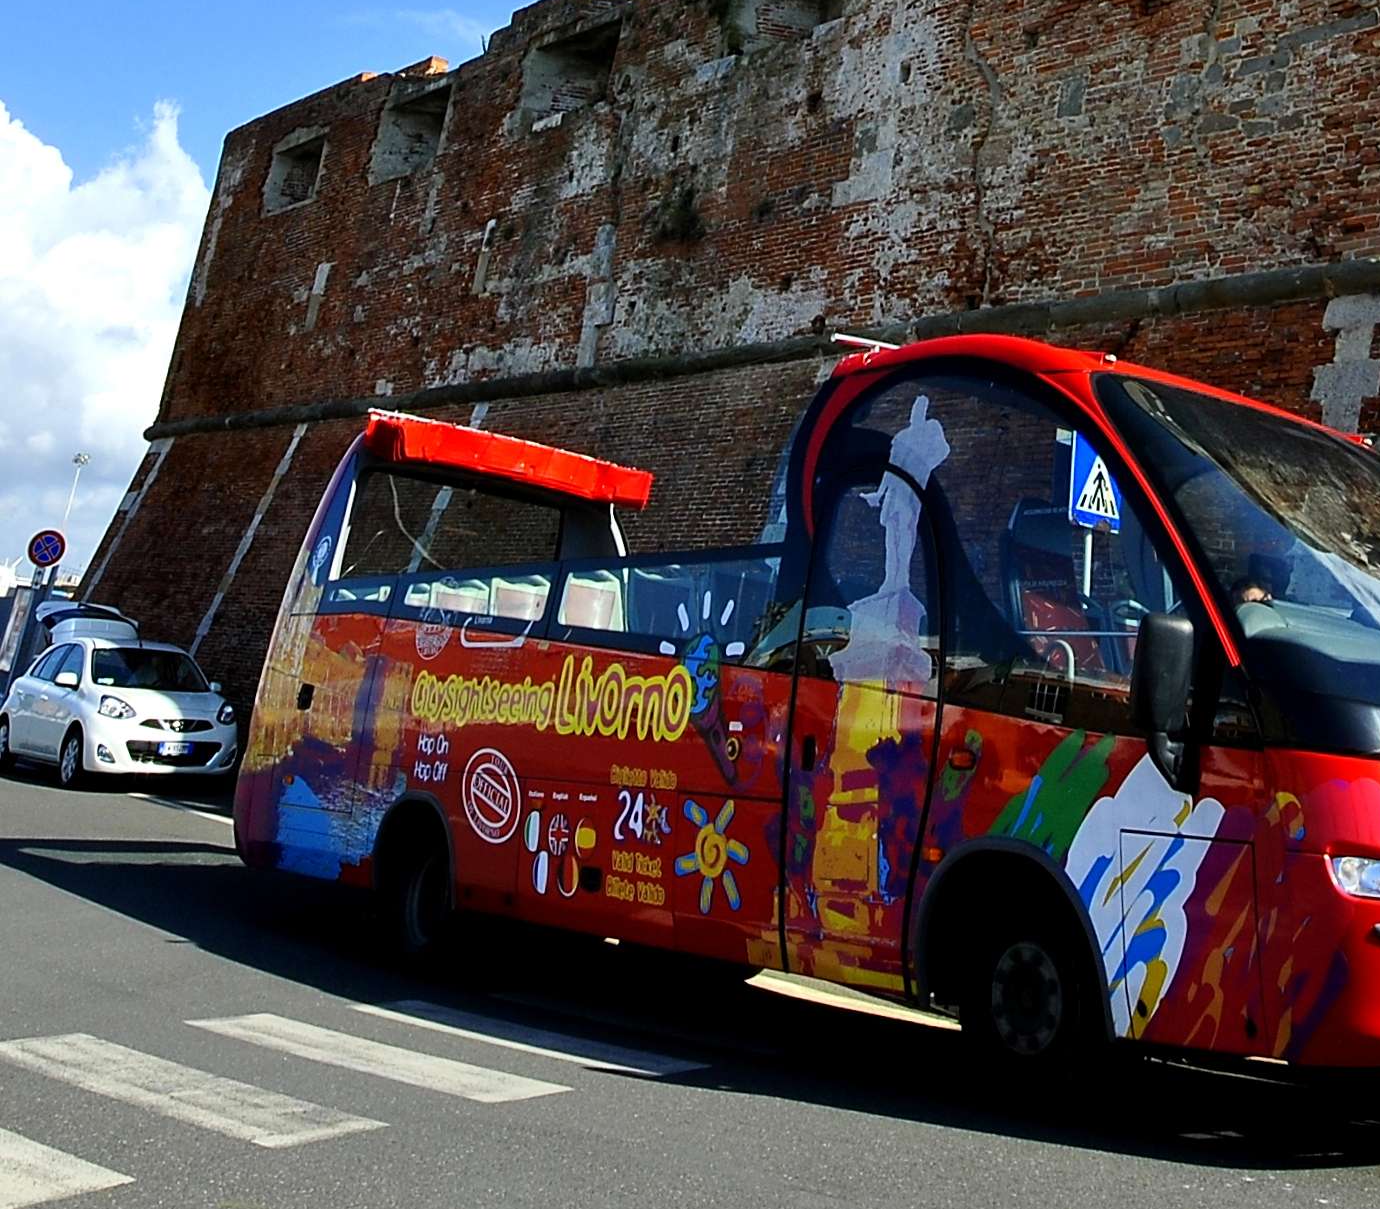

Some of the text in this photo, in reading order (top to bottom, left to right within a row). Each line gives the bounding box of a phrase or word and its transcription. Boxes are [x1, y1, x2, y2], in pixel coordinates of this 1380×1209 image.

[417, 733, 449, 756] Hop On
[413, 759, 449, 782] Hop Off
[473, 773, 509, 815] OFFICIAL
[614, 790, 644, 840] 24
